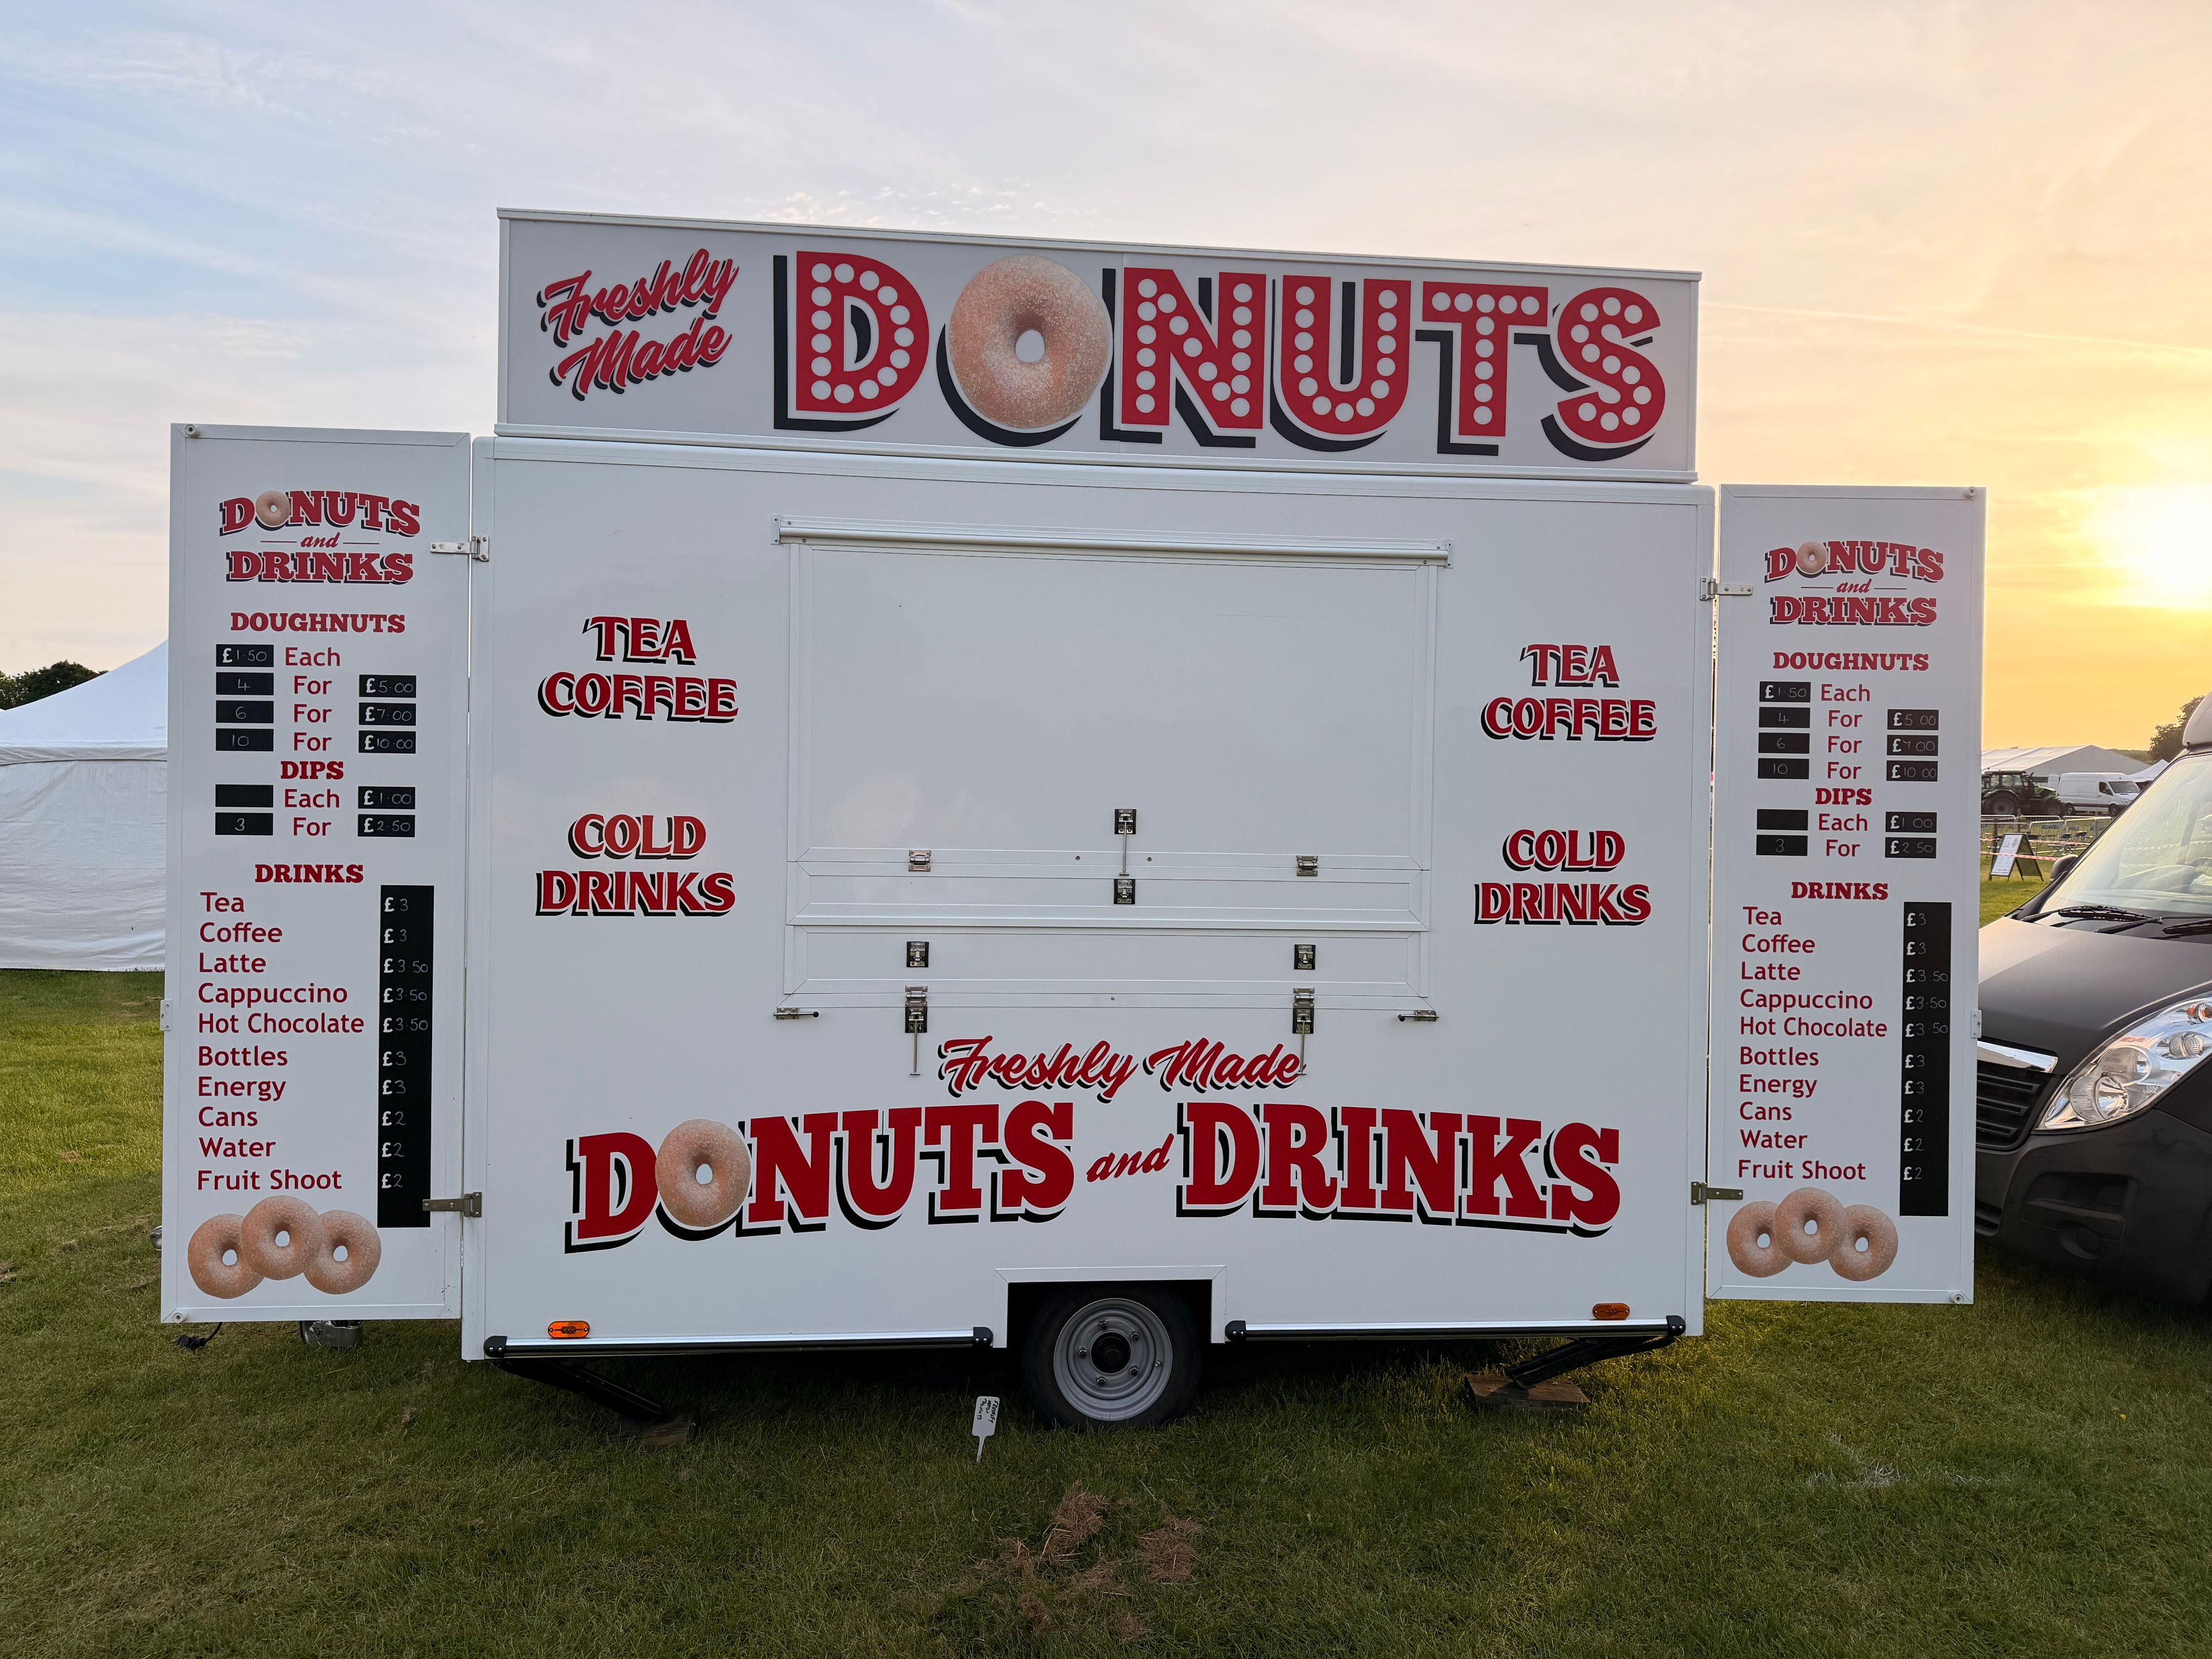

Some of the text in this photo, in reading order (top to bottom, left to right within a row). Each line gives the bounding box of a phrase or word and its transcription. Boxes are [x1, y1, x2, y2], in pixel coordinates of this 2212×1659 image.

[536, 248, 739, 347] Freshly
[549, 317, 732, 402] Made
[774, 251, 1665, 461] DONUTS
[219, 490, 420, 536] DONUTS
[301, 533, 340, 548] and
[226, 551, 413, 585] DRINKS
[1764, 540, 1944, 583] DONUTS
[1837, 578, 1872, 593] and
[1770, 596, 1937, 626] DRINKS
[231, 613, 405, 633] DOUGHNUTS
[582, 616, 697, 665] TEA
[286, 647, 340, 666] Each
[1520, 644, 1620, 688] TEA
[1774, 652, 1929, 671] DOUGHNUTS
[238, 679, 250, 691] 4
[294, 676, 331, 694] For
[1821, 684, 1870, 701] Each
[537, 672, 739, 724] COFFEE
[236, 707, 247, 719] 6
[294, 704, 331, 723] For
[1480, 697, 1657, 741] COFFEE
[1779, 713, 1789, 723] 4
[1829, 710, 1862, 728] For
[233, 735, 248, 746] 10
[294, 733, 331, 751] For
[1777, 738, 1785, 748] 6
[1828, 736, 1859, 753] For
[281, 761, 344, 779] DIPS
[1774, 764, 1788, 774] 10
[1828, 762, 1861, 779] For
[285, 789, 339, 808] Each
[1816, 788, 1872, 805] DIPS
[235, 819, 244, 831] 3
[293, 817, 331, 836] For
[1819, 813, 1868, 831] Each
[568, 813, 706, 859] COLD
[1502, 829, 1625, 872] COLD
[1777, 839, 1783, 853] 3
[1827, 840, 1859, 857] For
[255, 864, 363, 883] DRINKS
[536, 870, 736, 916] DRINKS
[1791, 882, 1888, 900] DRINKS
[201, 892, 244, 912] Tea
[1474, 882, 1651, 926] DRINKS
[1743, 907, 1782, 925] Tea
[200, 922, 282, 942] Coffee
[1743, 934, 1815, 953] Coffee
[200, 953, 266, 973] Latte
[1742, 963, 1800, 980] Latte
[199, 983, 347, 1008] Cappuccino
[1741, 990, 1873, 1012] Cappuccino
[199, 1014, 238, 1033] Hot
[249, 1013, 364, 1033] Chocolate
[1741, 1018, 1775, 1035] Hot
[1785, 1017, 1887, 1037] Chocolate
[199, 1046, 287, 1066] Bottles
[1741, 1047, 1818, 1066] Bottles
[938, 1035, 1306, 1103] Freshly Made
[199, 1077, 285, 1101] Energy
[1740, 1074, 1816, 1098] Energy
[199, 1107, 257, 1127] Cans
[1740, 1102, 1791, 1120] Cans
[199, 1138, 275, 1157] Water
[1741, 1131, 1806, 1149] Water
[565, 1100, 1621, 1253] DONUTS and DRINKS
[1739, 1160, 1792, 1179] Fruit
[1802, 1161, 1865, 1180] Shoot
[198, 1171, 259, 1190] Fruit
[270, 1171, 341, 1190] Shoot
